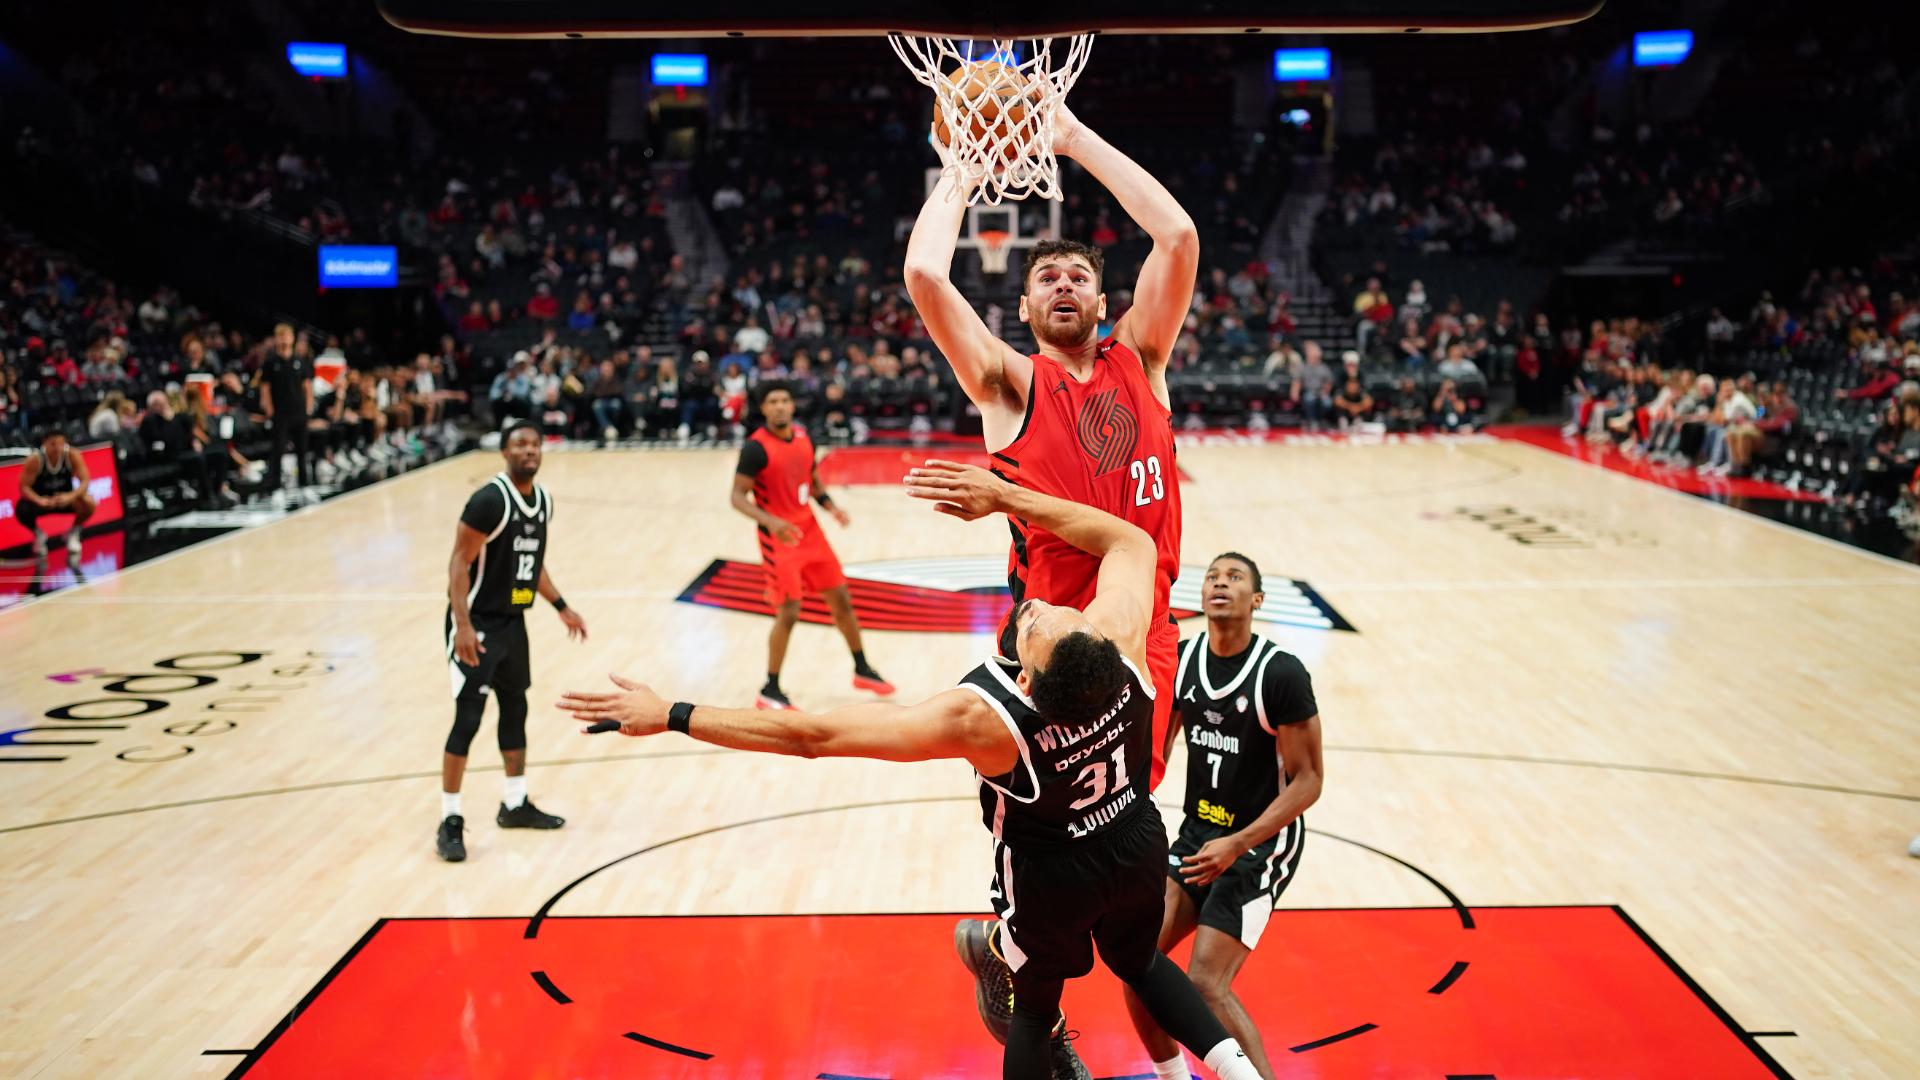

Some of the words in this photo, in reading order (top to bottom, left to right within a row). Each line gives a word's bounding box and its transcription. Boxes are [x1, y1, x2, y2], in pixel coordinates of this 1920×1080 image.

[1130, 455, 1164, 507] 23
[516, 553, 535, 580] 12
[1054, 721, 1133, 772] payabl
[1190, 724, 1240, 754] London
[1069, 743, 1130, 810] 31
[1206, 752, 1222, 789] 7
[1197, 799, 1236, 827] Saily
